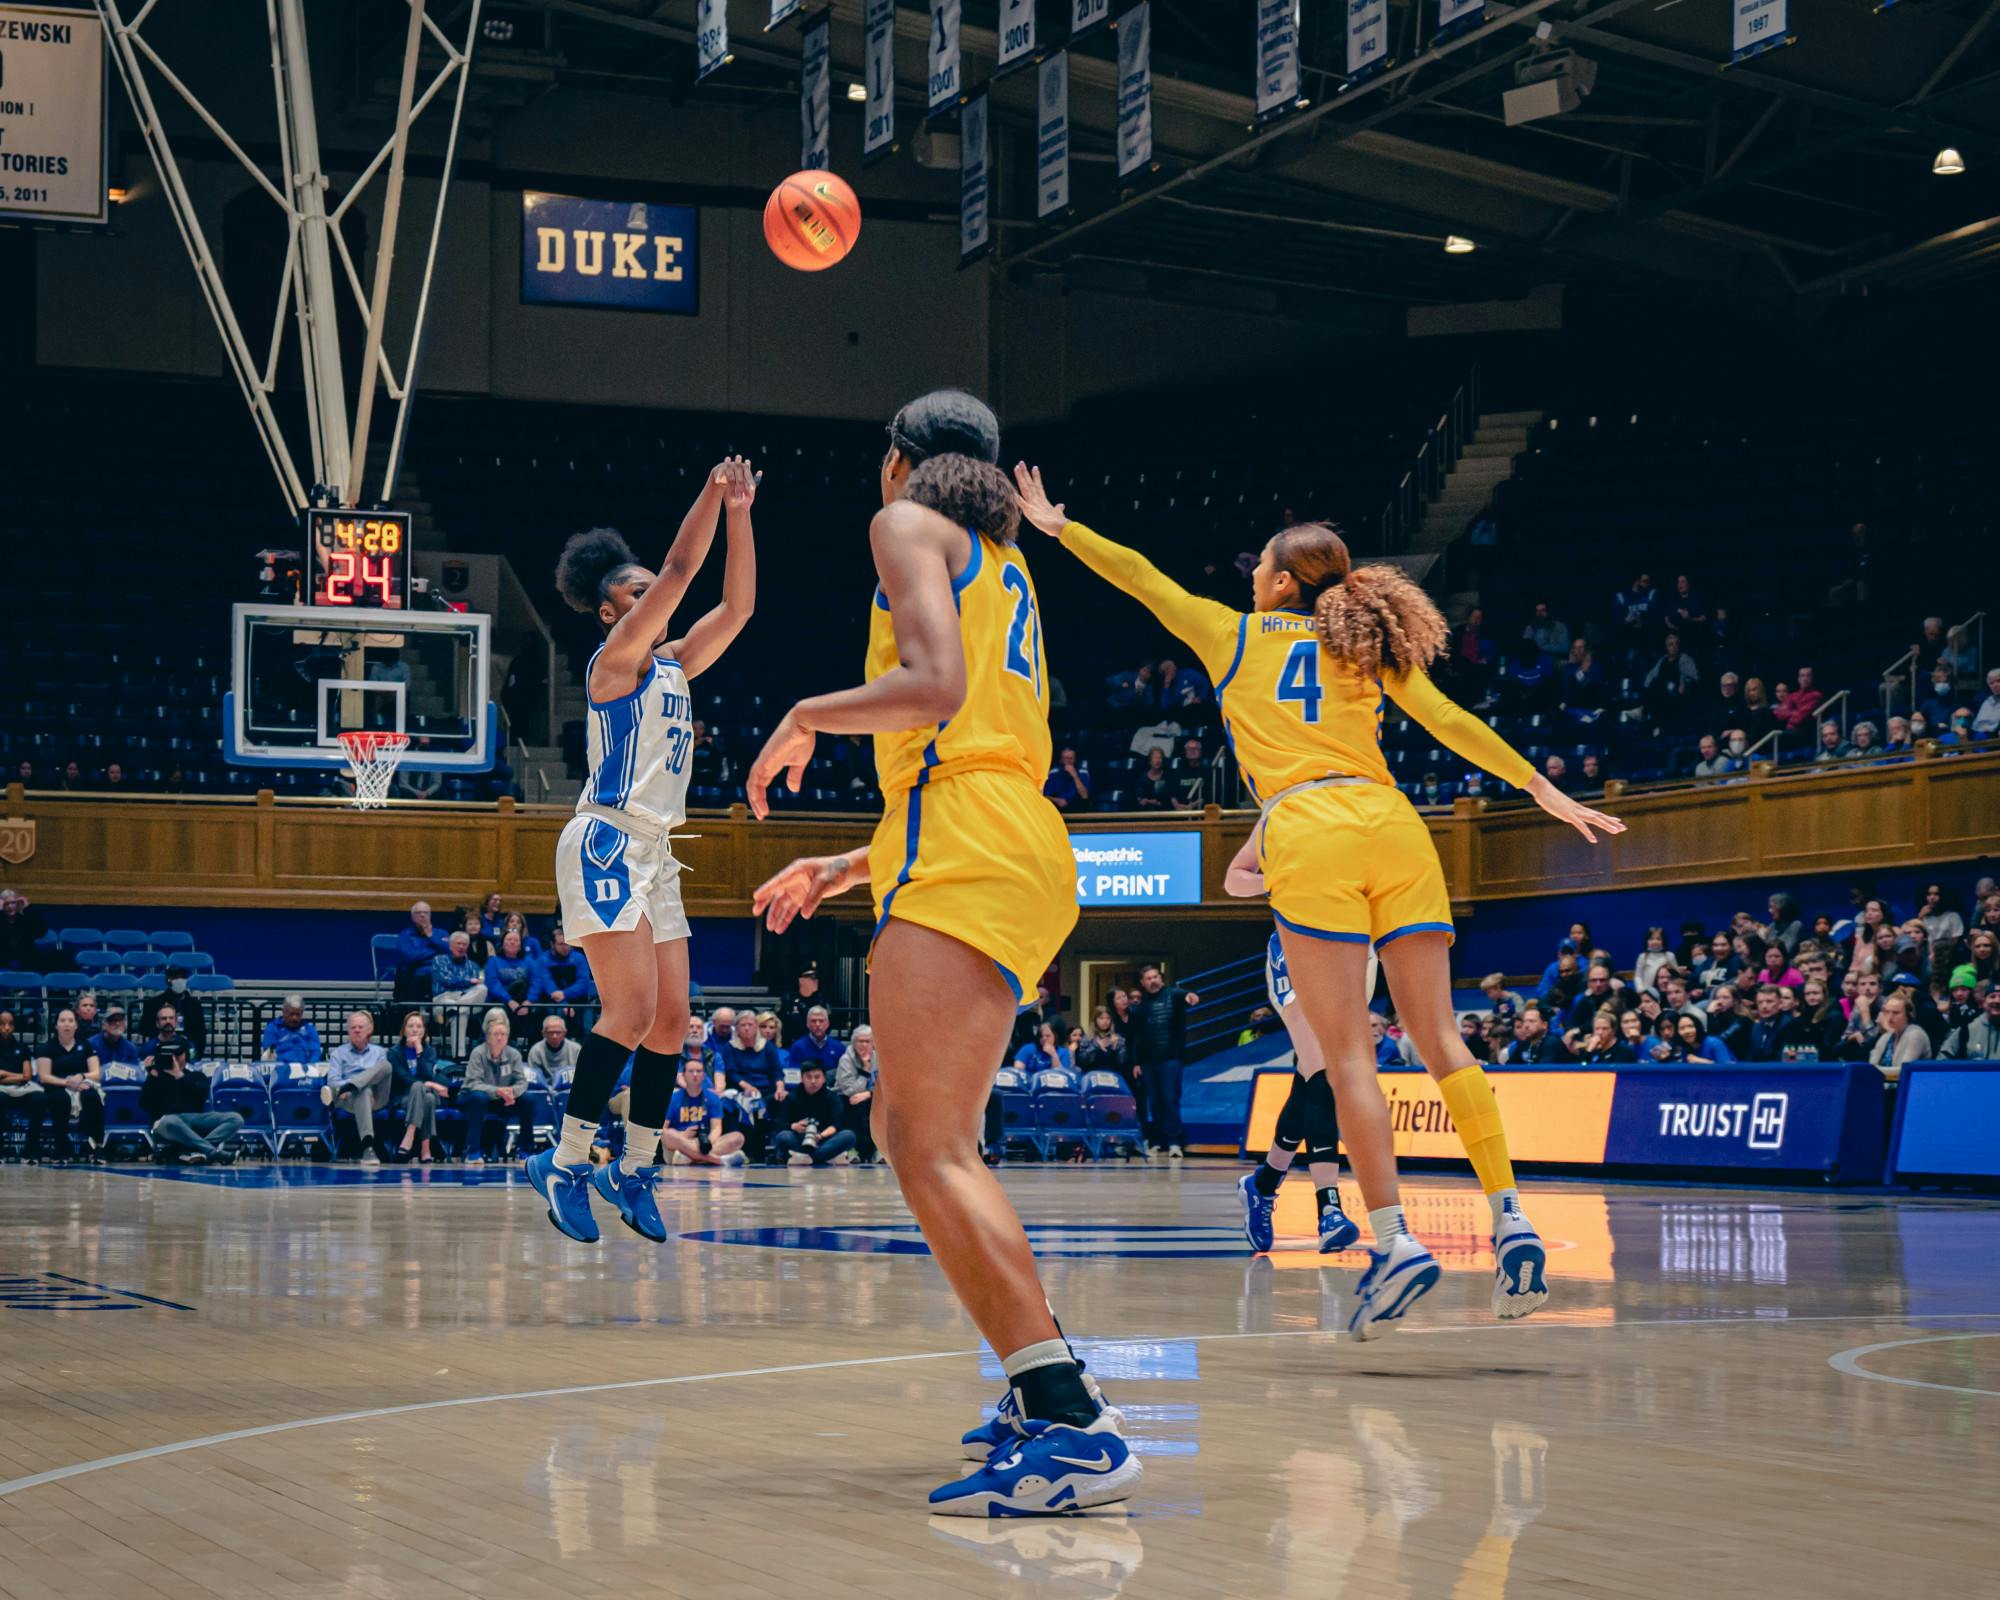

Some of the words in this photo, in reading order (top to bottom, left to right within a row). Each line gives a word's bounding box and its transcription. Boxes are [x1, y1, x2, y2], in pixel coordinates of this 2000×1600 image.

[1748, 14, 1769, 34] 1997
[14, 187, 48, 202] 2011
[537, 227, 683, 281] DUKE
[336, 521, 400, 553] 4:28
[327, 552, 391, 604] 24
[1275, 639, 1325, 725] 4
[665, 726, 692, 775] 30
[0, 830, 30, 854] 20
[593, 878, 620, 903] D
[1096, 874, 1170, 897] PRINT
[1658, 1103, 1749, 1137] TRUIST
